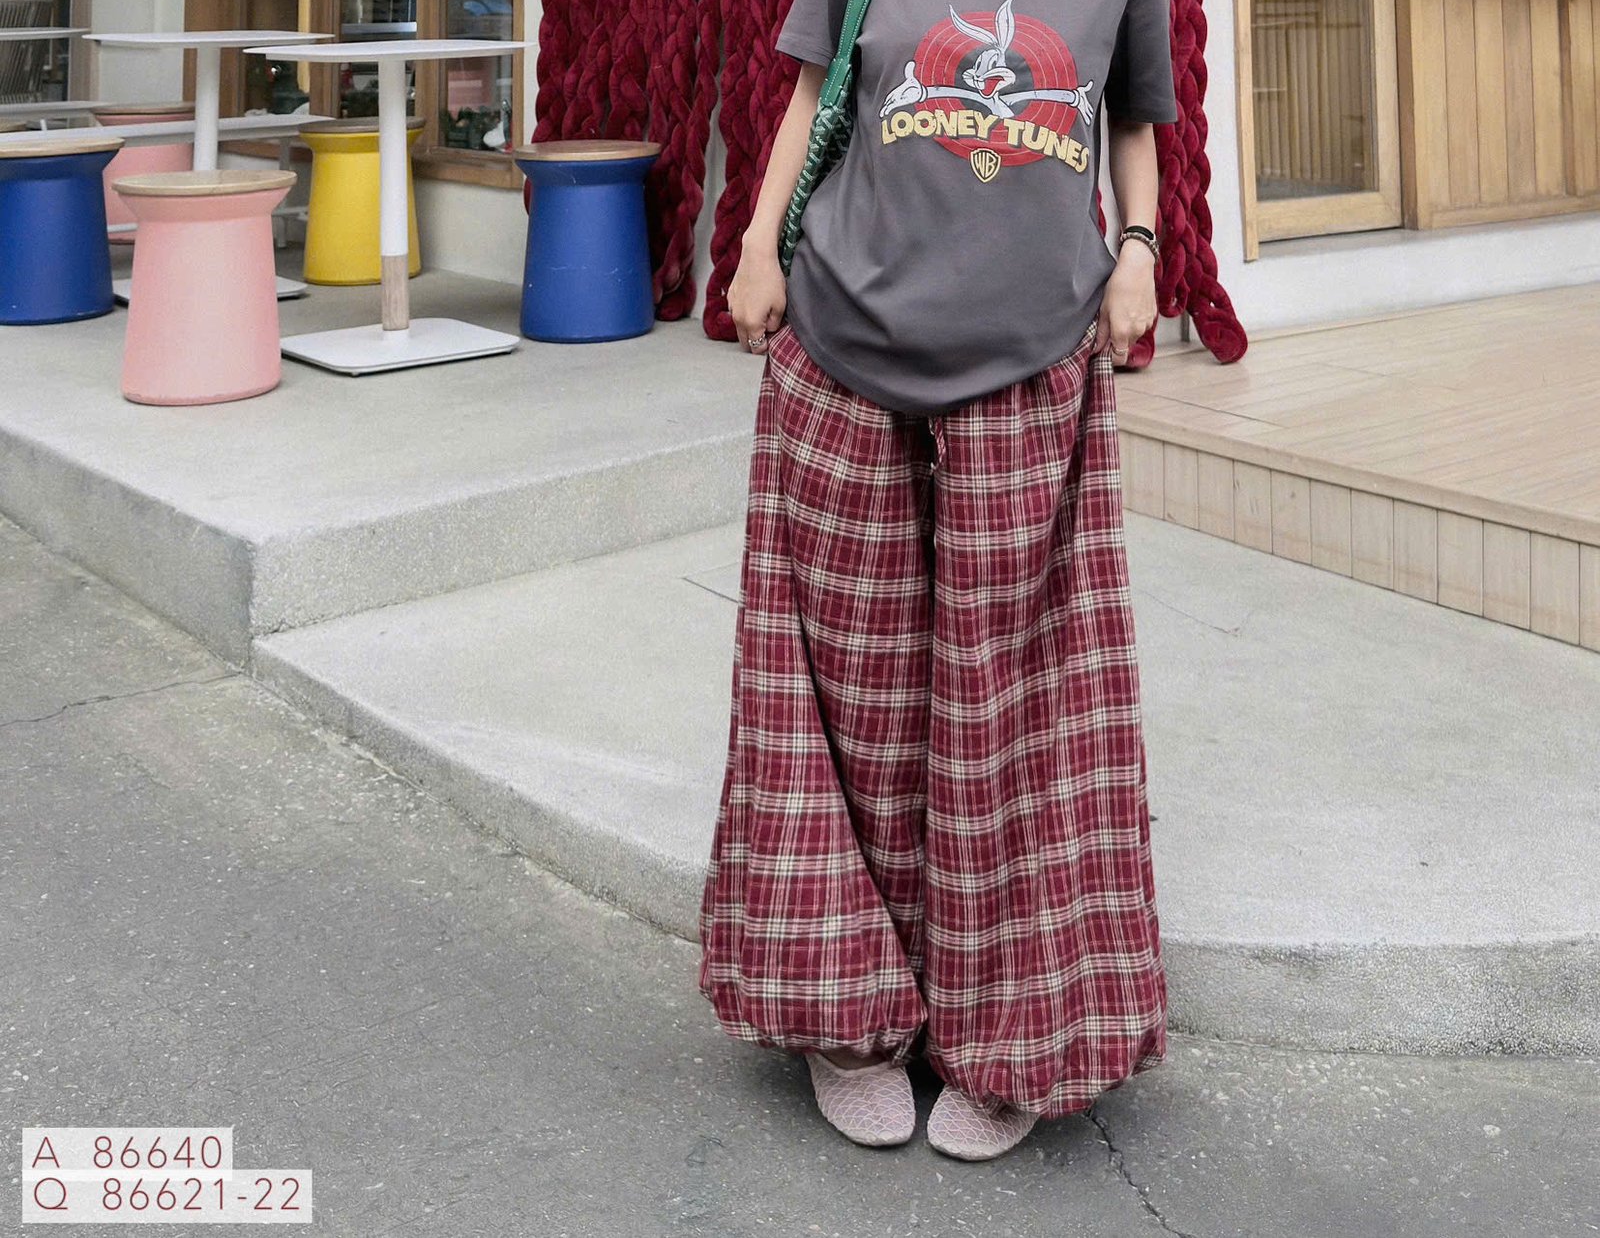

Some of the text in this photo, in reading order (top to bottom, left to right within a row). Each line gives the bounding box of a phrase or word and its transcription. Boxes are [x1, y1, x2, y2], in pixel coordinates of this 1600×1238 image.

[881, 109, 1090, 173] LOONEY TUNES
[972, 150, 998, 180] WB
